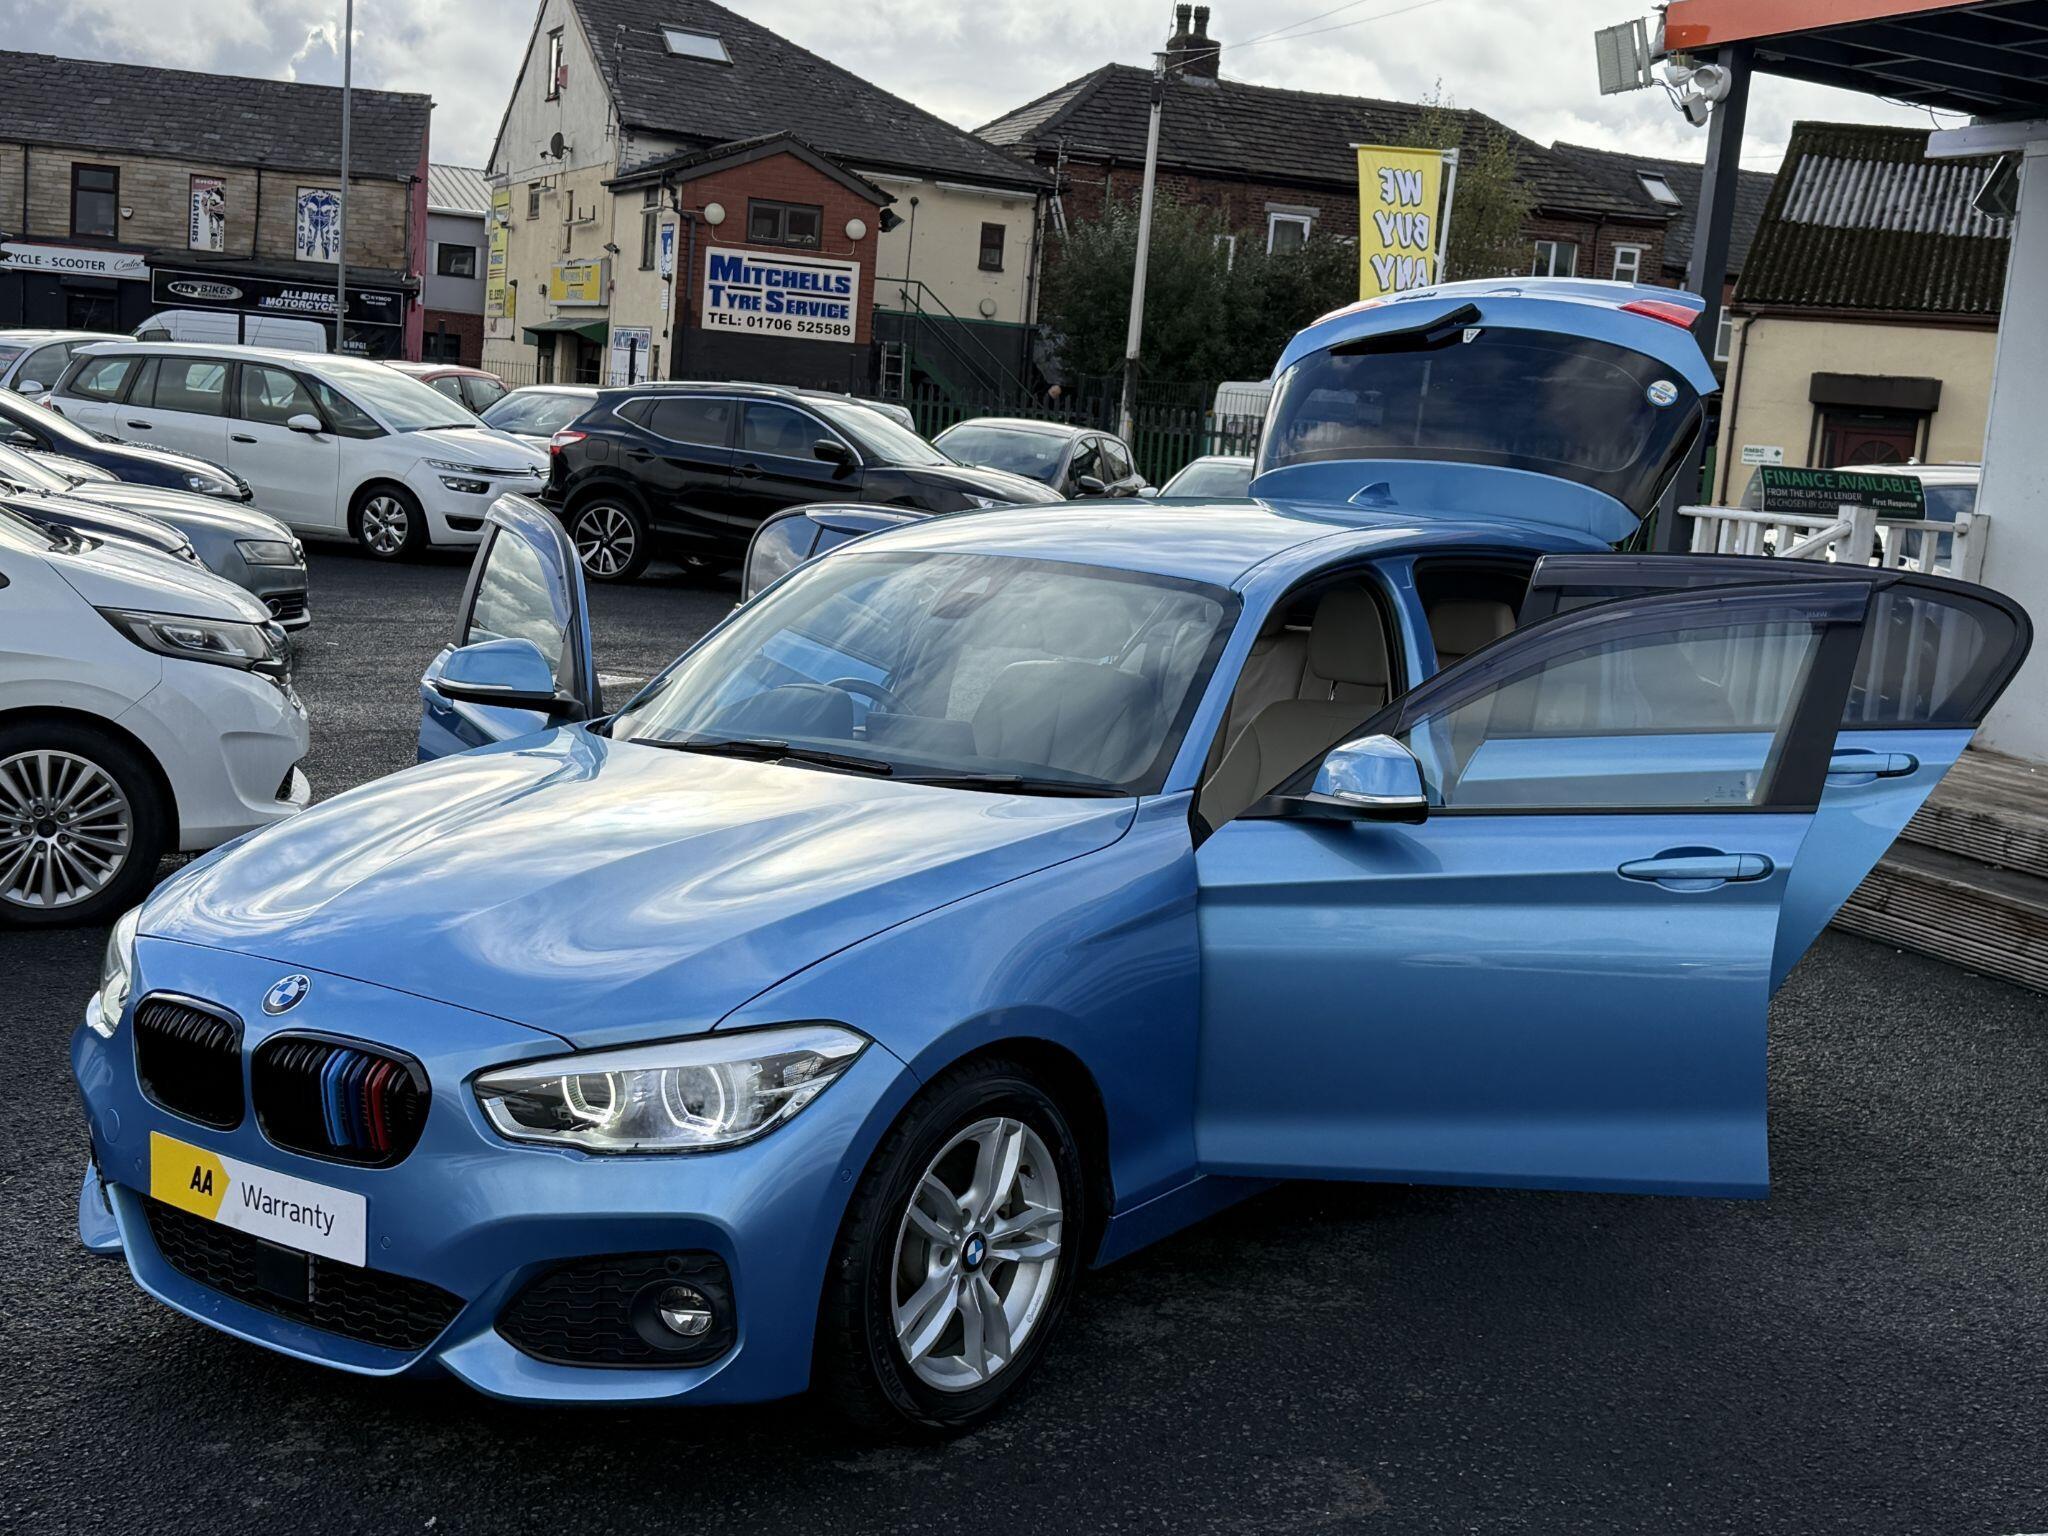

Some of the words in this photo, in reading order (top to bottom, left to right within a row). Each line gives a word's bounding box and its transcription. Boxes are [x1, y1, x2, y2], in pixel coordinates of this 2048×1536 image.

[191, 193, 200, 242] LEATHERS
[52, 257, 105, 271] SCOOTER
[709, 253, 851, 294] MITCHELLS
[176, 284, 192, 293] ALL
[200, 284, 234, 296] BIKES
[280, 289, 336, 302] ALLBIKES
[708, 284, 761, 312] TYRE
[765, 290, 849, 319] SERVICE
[708, 312, 742, 326] TEL:
[746, 316, 792, 331] 01706
[797, 321, 850, 336] 525589
[1764, 470, 1836, 488] FINANCE
[1838, 474, 1922, 494] AVAILABLE
[1766, 488, 1788, 497] FROM
[1790, 489, 1804, 497] THE
[1834, 491, 1862, 501] LENDER
[1766, 498, 1777, 506] AS
[1777, 499, 1807, 508] CHOSEN
[1872, 499, 1887, 507] First
[1887, 501, 1918, 509] Response
[190, 1165, 213, 1197] AA
[241, 1181, 335, 1237] Warranty
